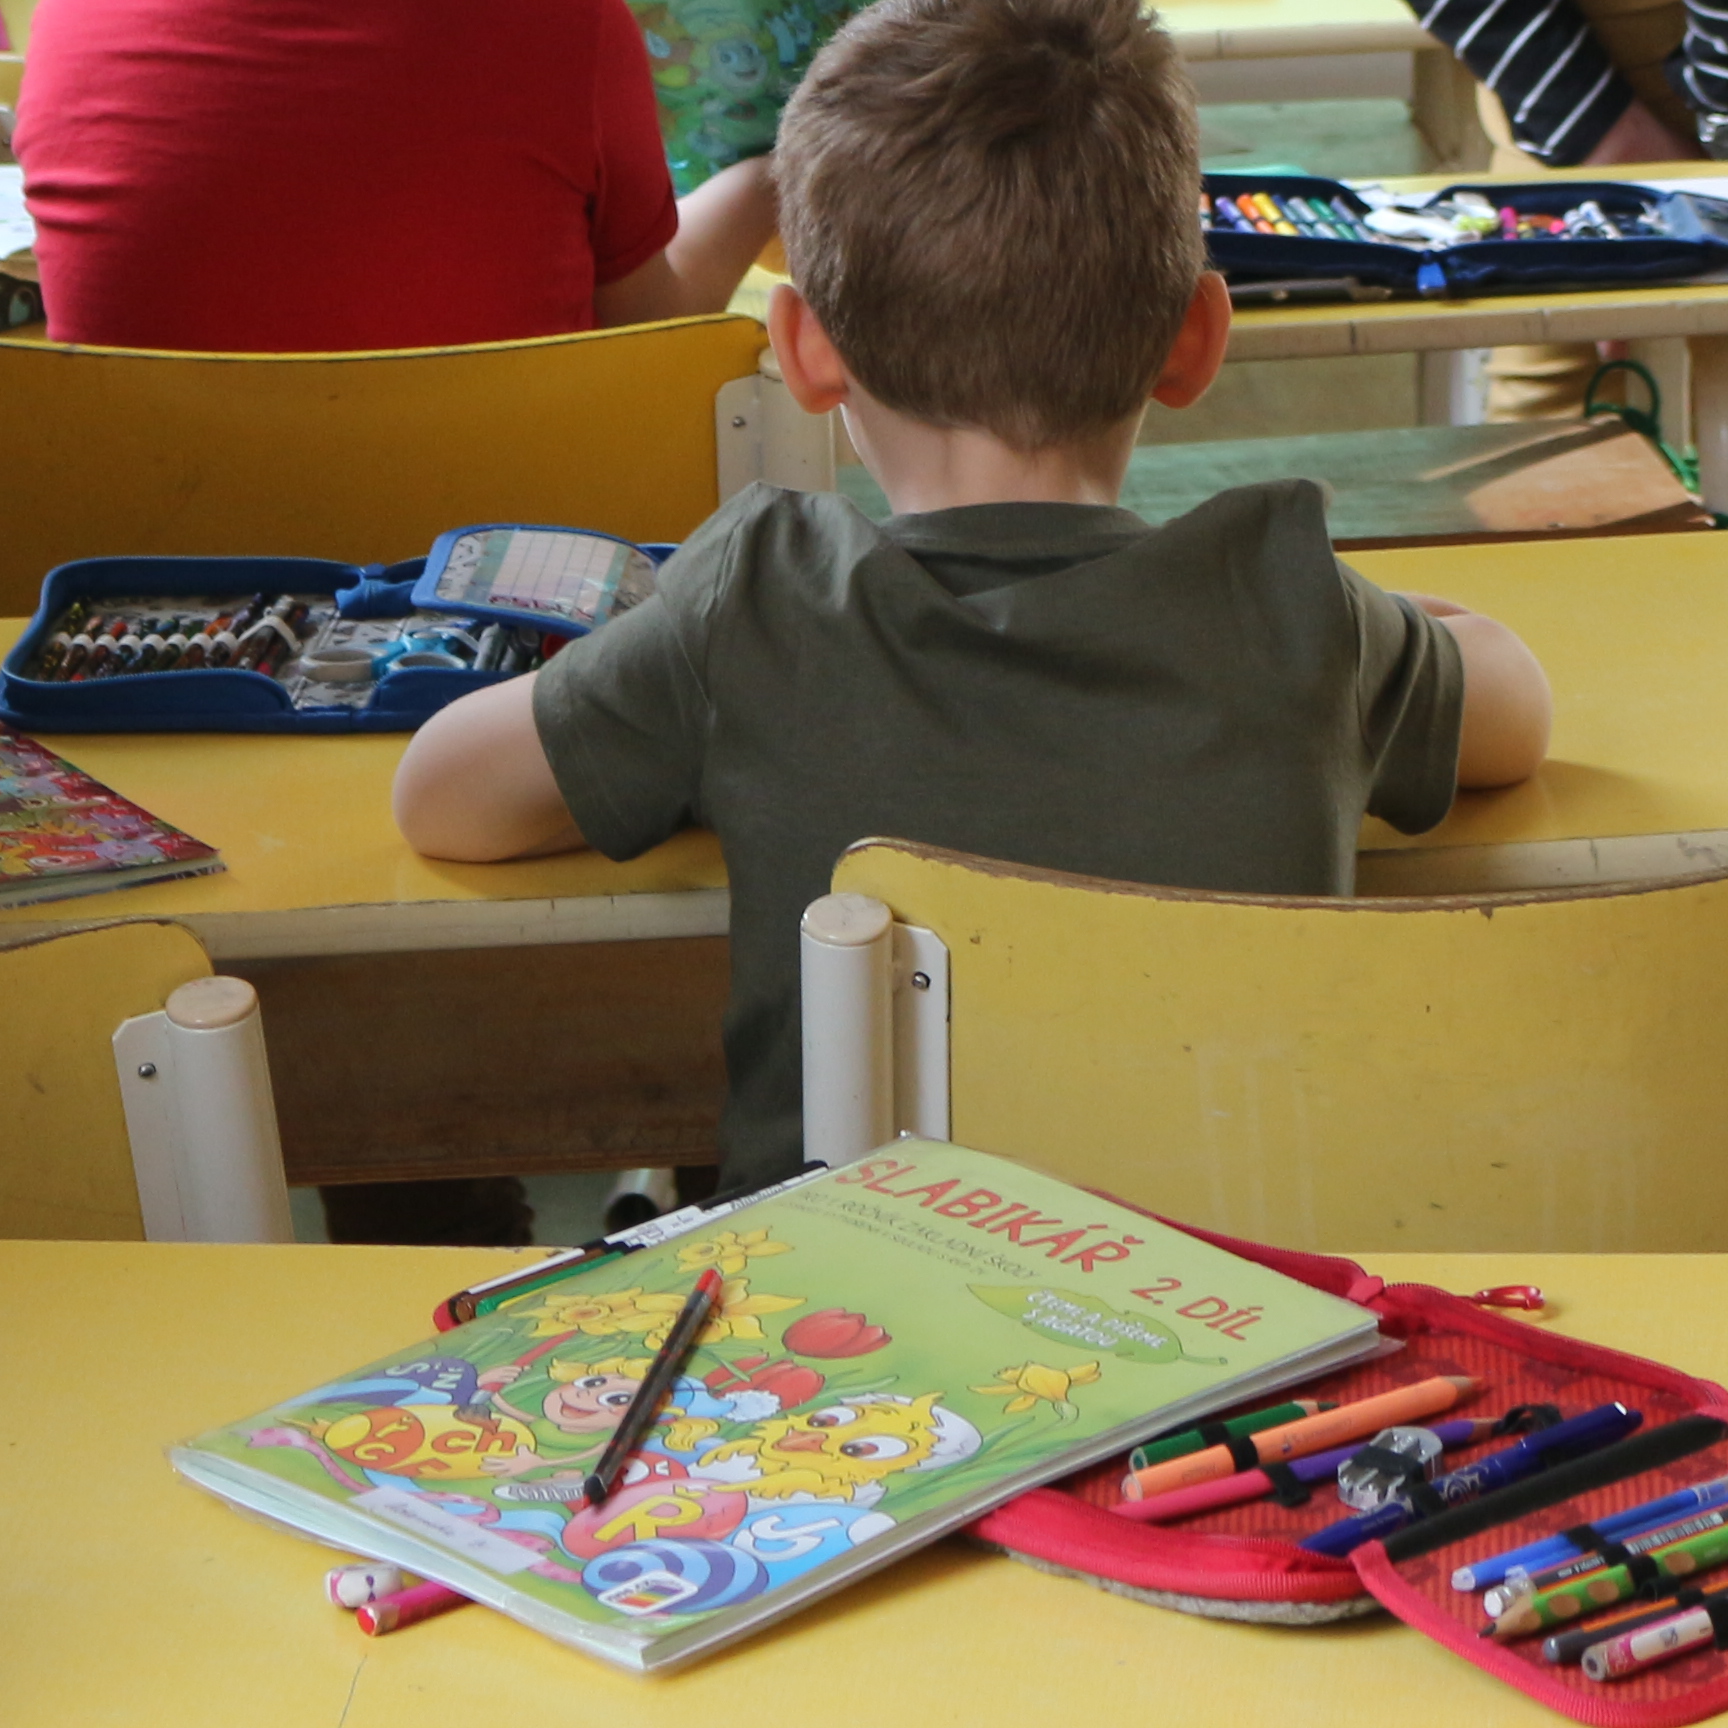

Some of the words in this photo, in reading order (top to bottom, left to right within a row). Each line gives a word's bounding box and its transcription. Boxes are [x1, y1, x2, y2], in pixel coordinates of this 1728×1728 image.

[835, 1160, 1144, 1272] SLABIKÁŘ
[1130, 1277, 1182, 1305] 2.
[1175, 1296, 1264, 1341] DÍL
